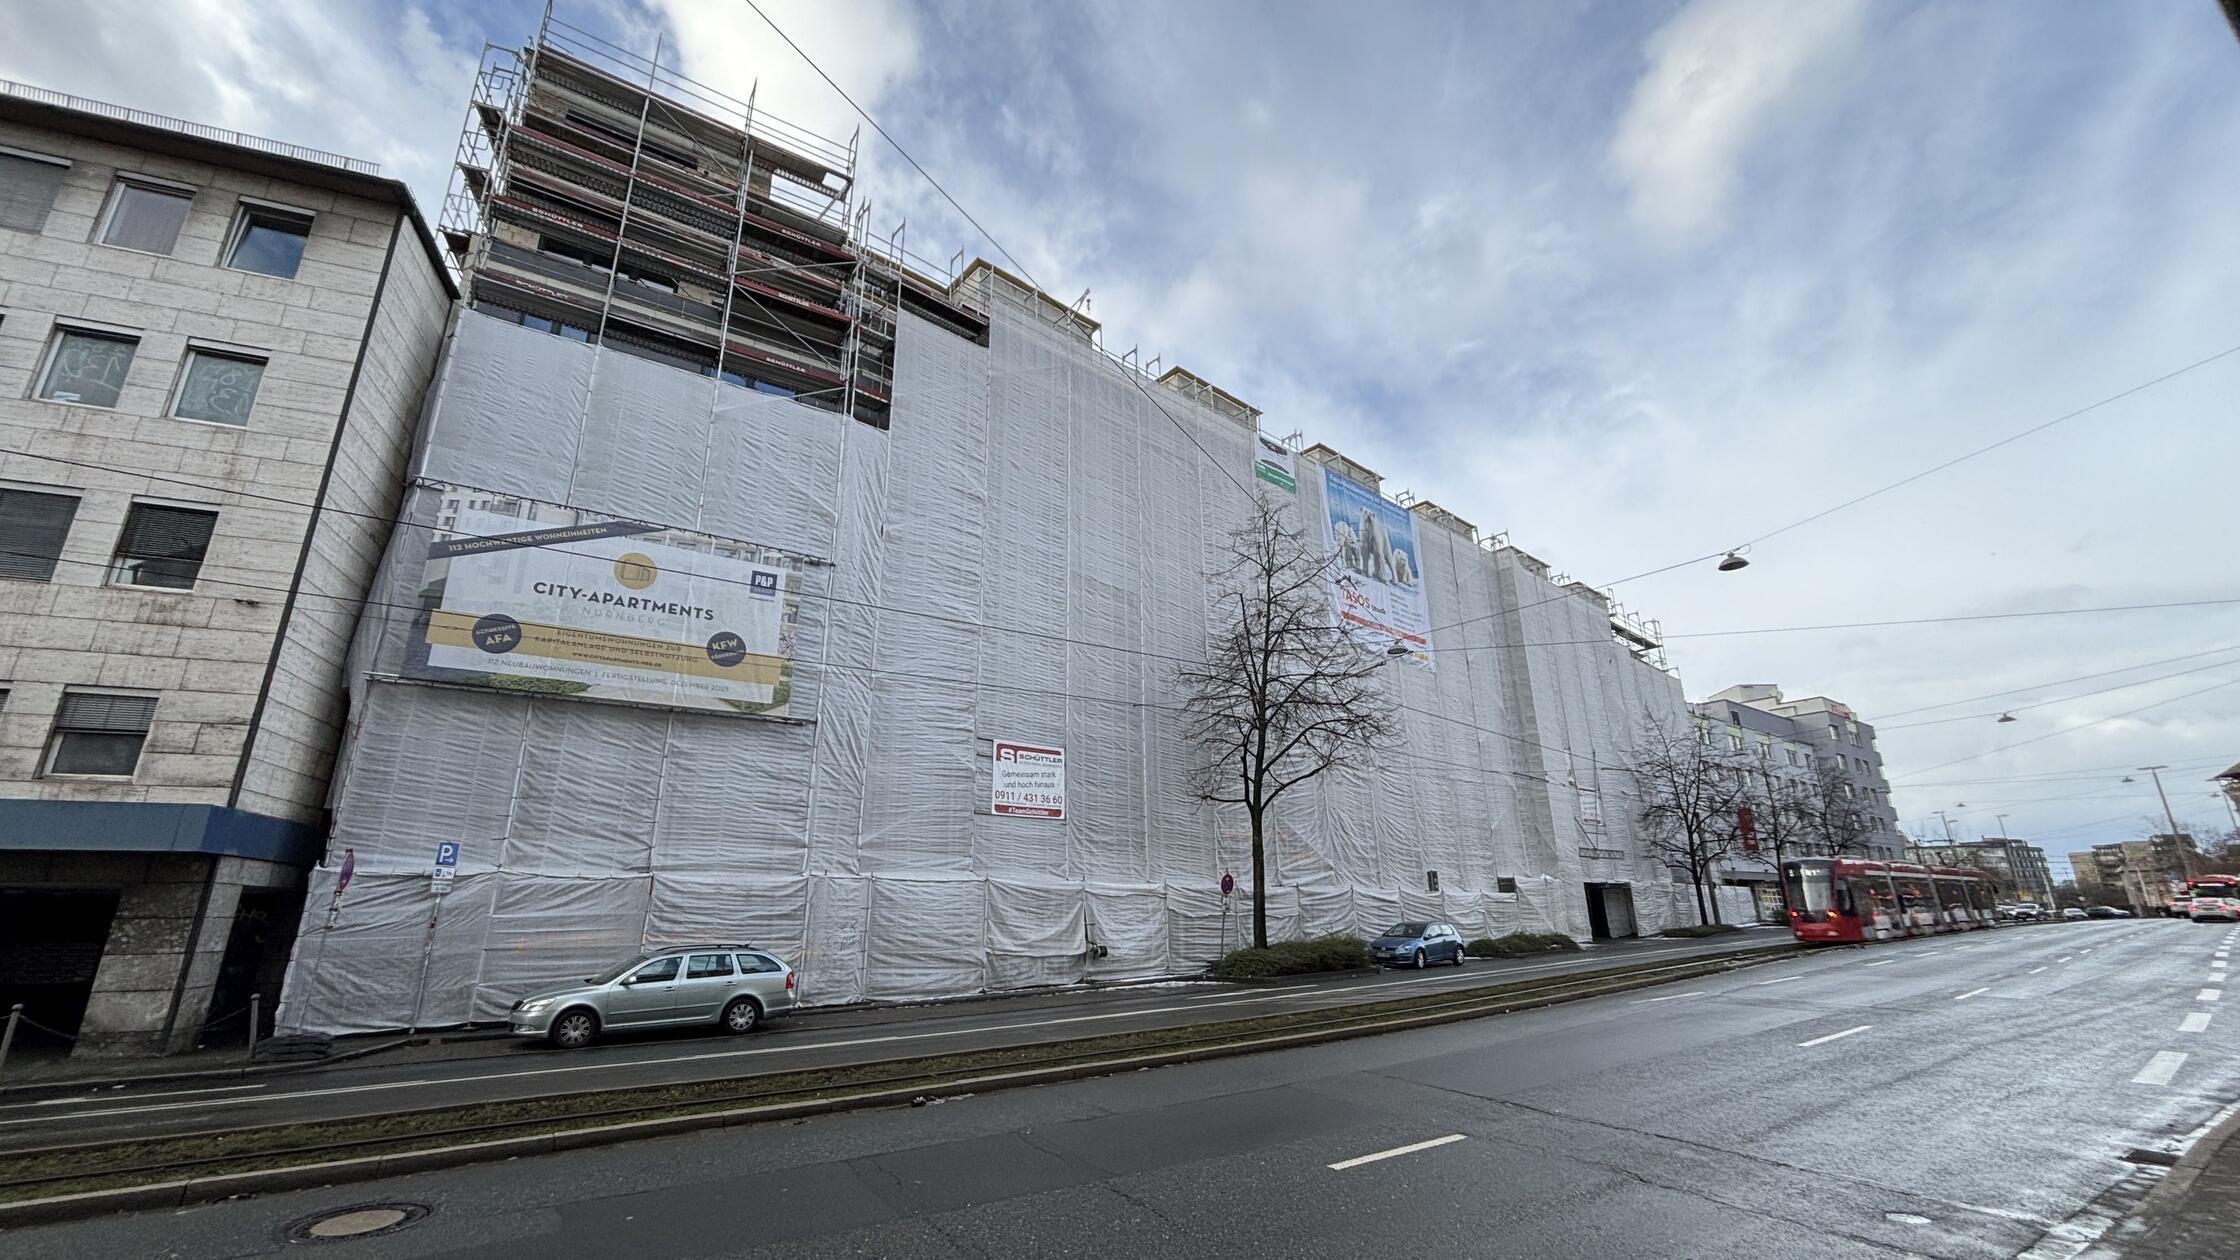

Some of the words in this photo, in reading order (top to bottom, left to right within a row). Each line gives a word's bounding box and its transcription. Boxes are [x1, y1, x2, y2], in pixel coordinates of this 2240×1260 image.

[535, 527, 608, 542] WOHNEINHEITEN
[755, 575, 774, 587] P&P
[533, 581, 714, 621] CITY-APARTMENTS
[486, 634, 512, 645] AFA
[712, 639, 738, 651] KFW
[1002, 770, 1039, 778] Gemeinsam
[1034, 781, 1055, 789] hinaus
[995, 790, 1015, 801] 0911
[1023, 793, 1038, 802] 431
[1041, 794, 1051, 804] 36
[1052, 795, 1063, 804] 60
[439, 844, 453, 863] P
